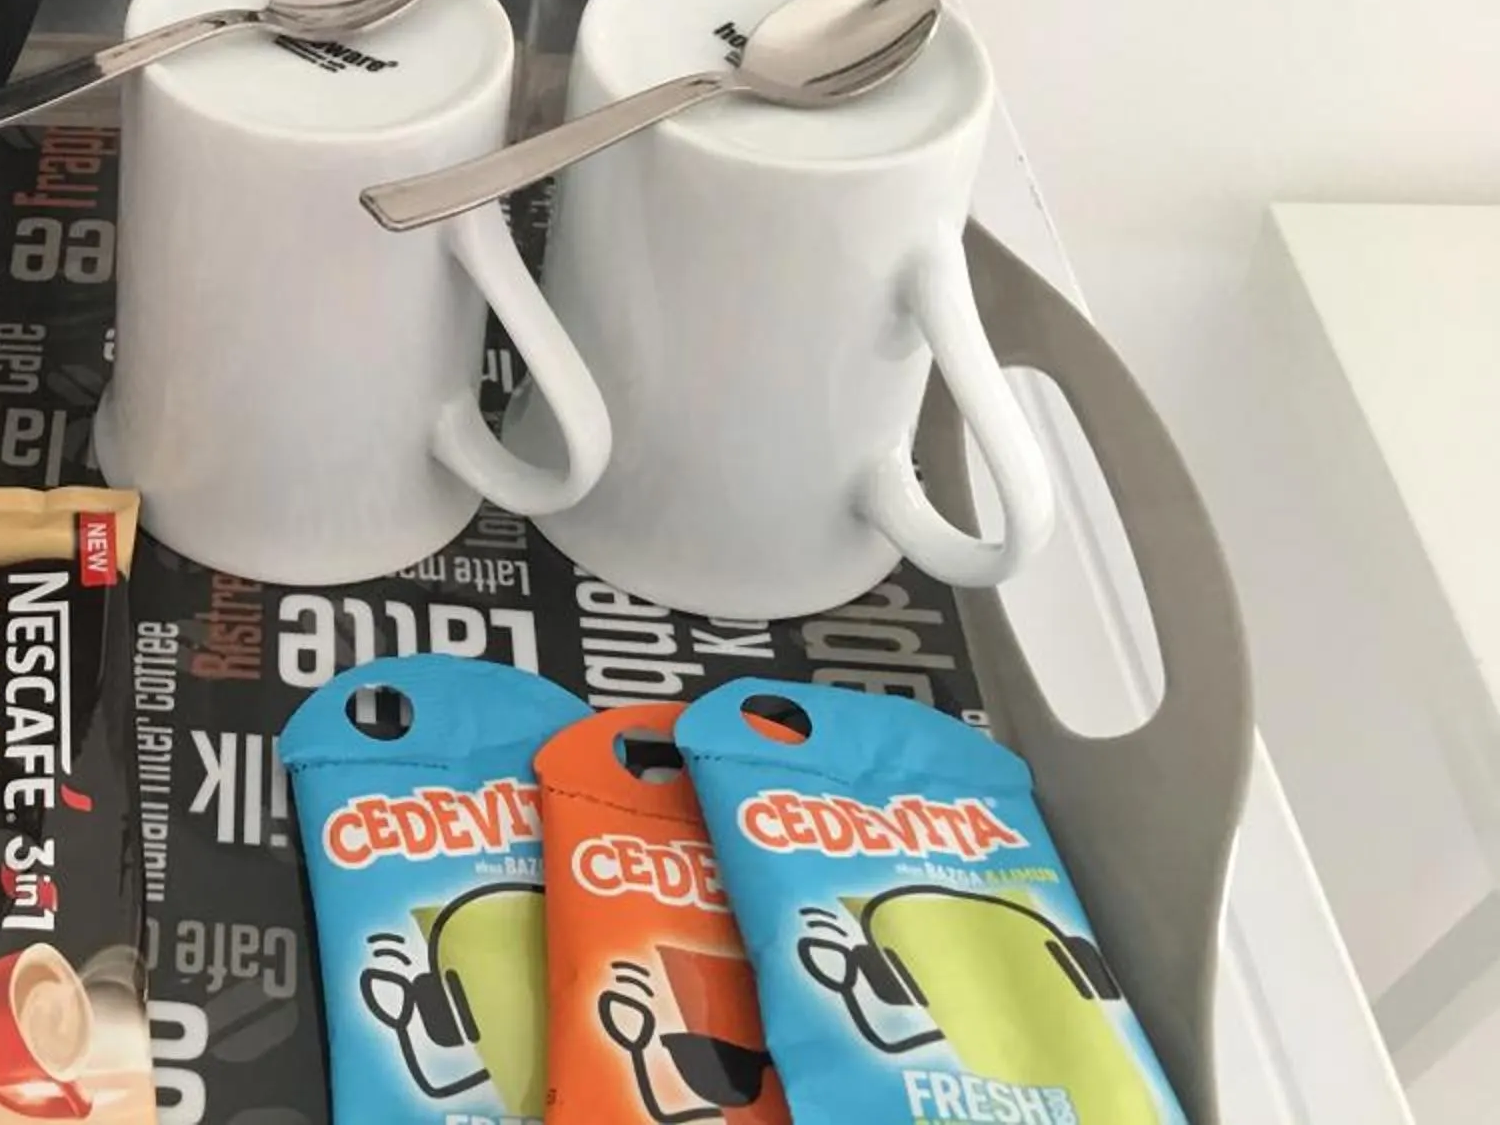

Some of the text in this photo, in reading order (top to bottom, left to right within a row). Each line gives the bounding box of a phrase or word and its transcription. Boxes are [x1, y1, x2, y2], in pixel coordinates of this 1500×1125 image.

[87, 521, 108, 573] NEW
[738, 790, 1028, 861] CEDEVITA
[902, 1069, 1054, 1125] FRESH
